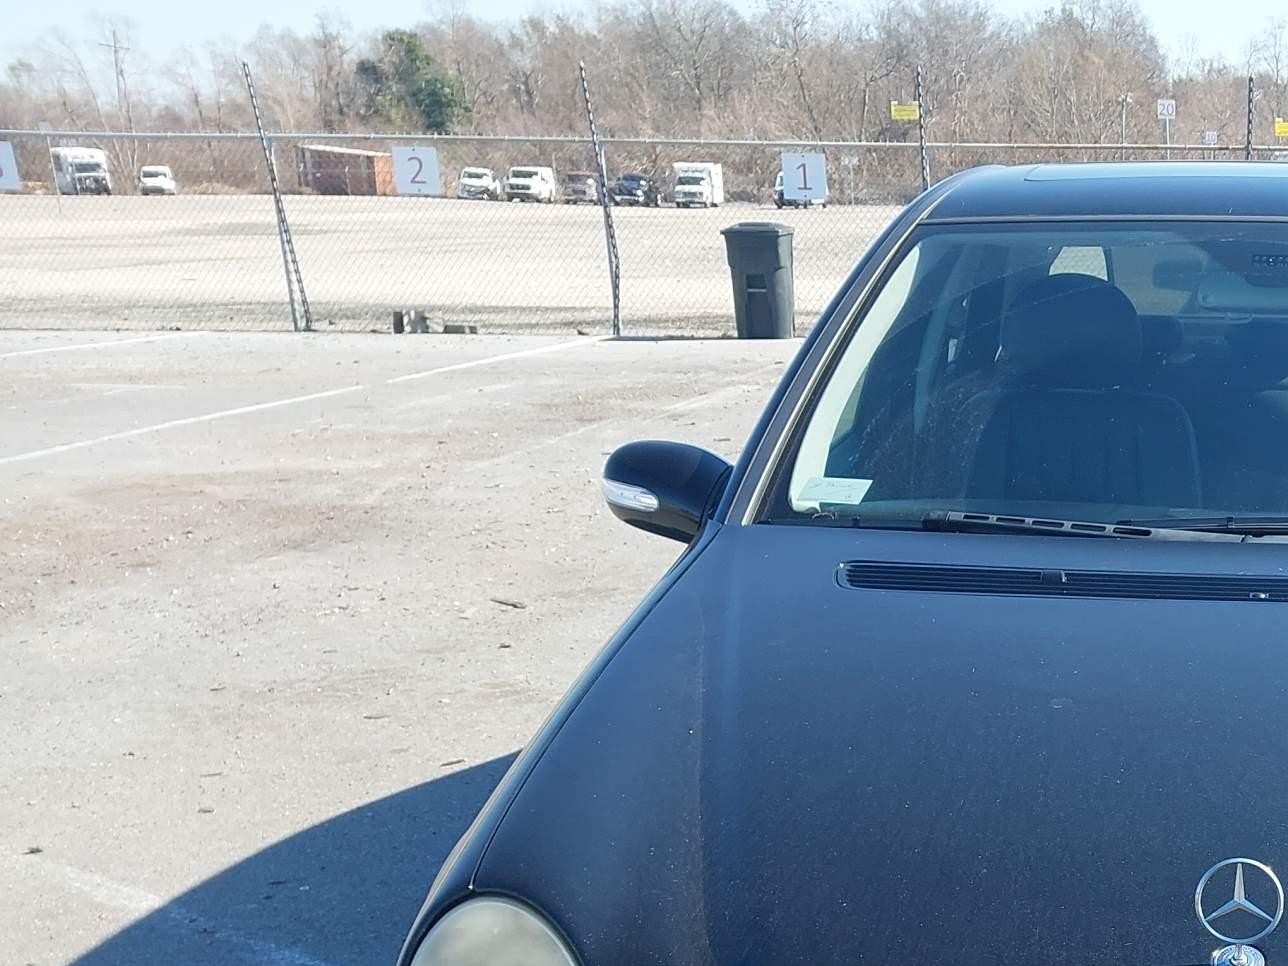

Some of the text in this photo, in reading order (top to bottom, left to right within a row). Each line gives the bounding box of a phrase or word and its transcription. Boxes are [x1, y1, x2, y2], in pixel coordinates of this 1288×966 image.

[1159, 103, 1174, 116] 20
[407, 156, 427, 184] 2
[796, 163, 813, 190] 1
